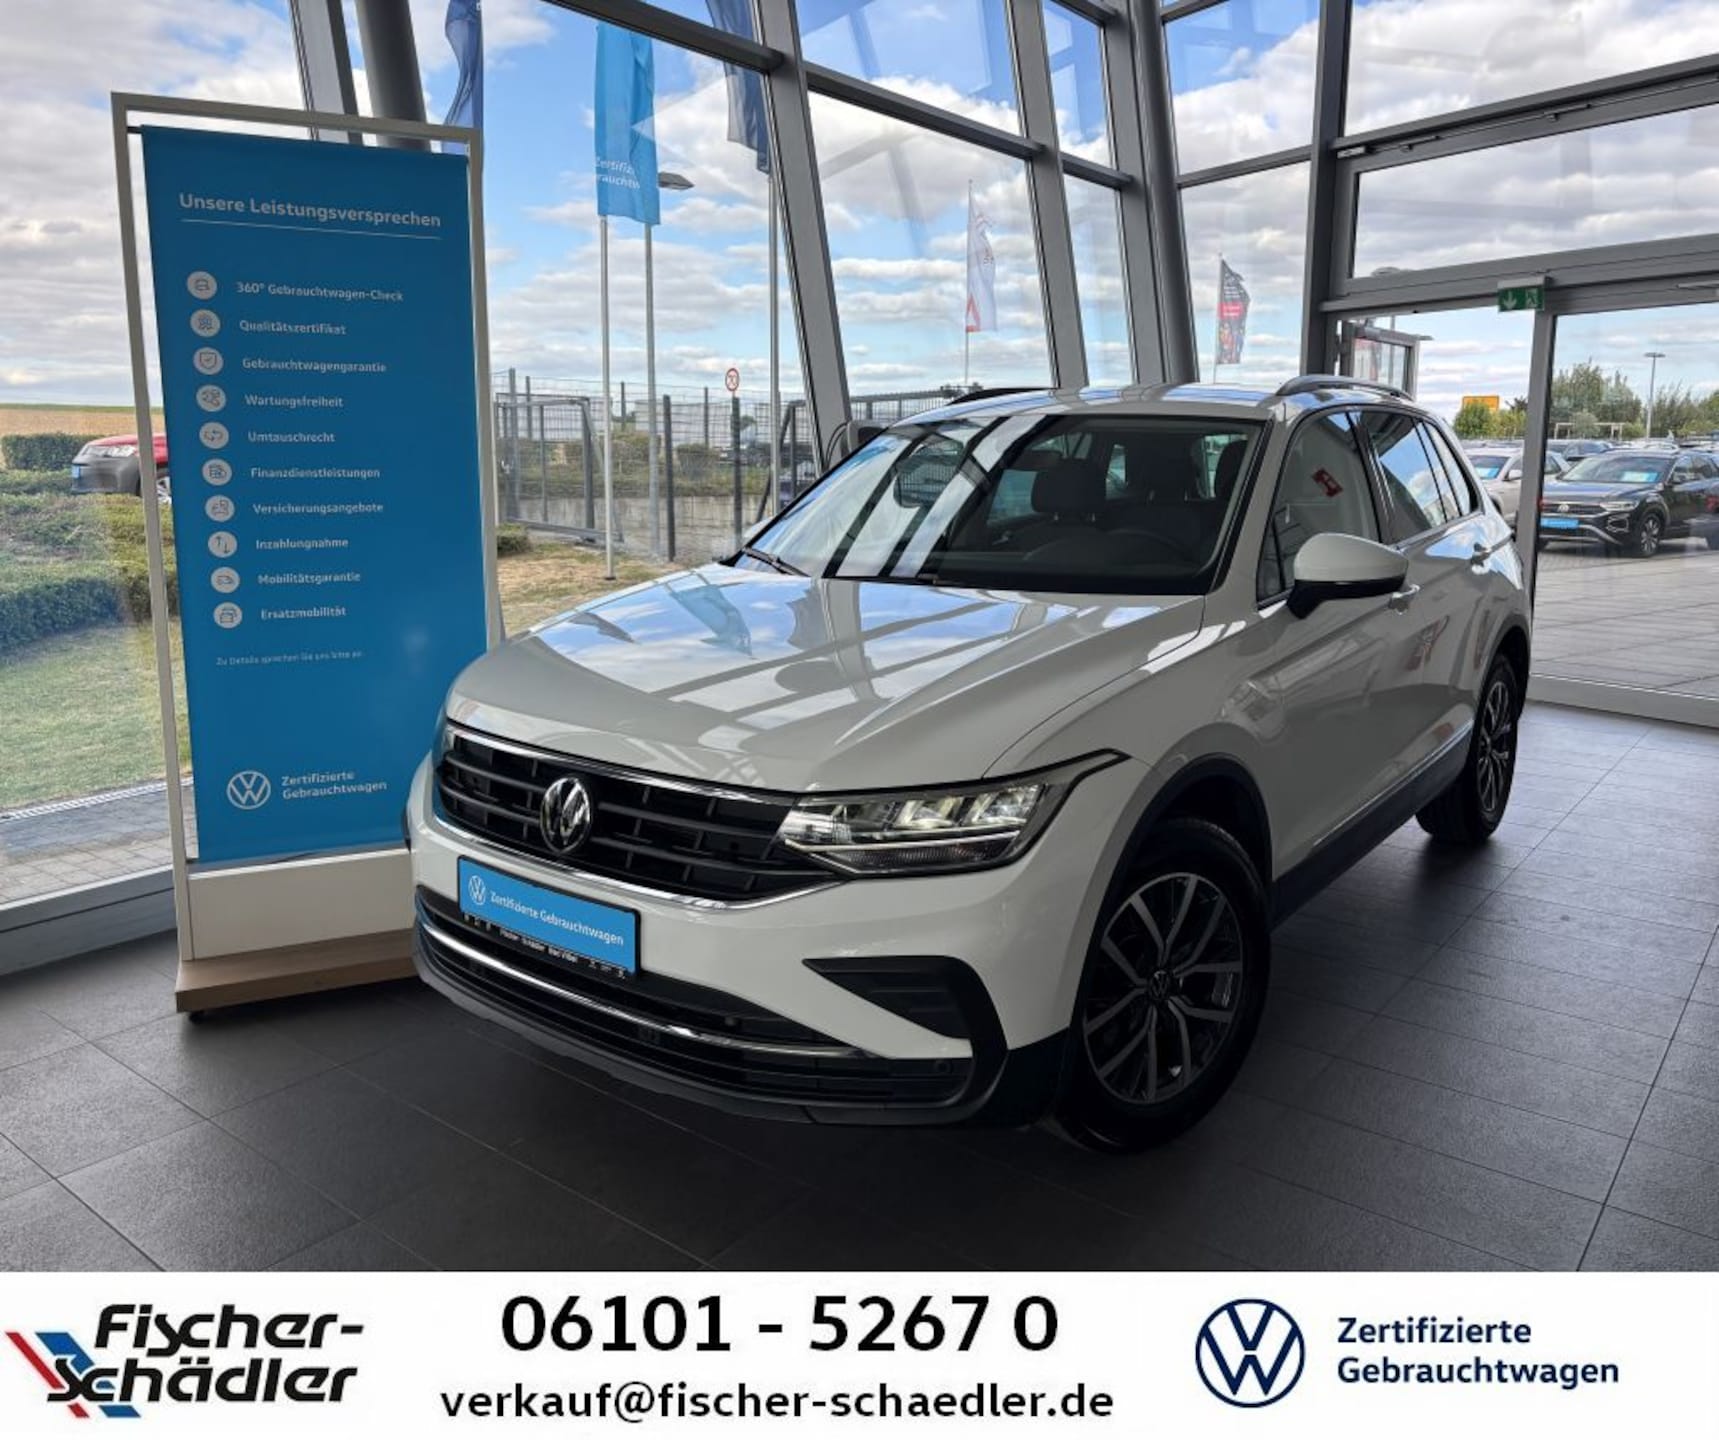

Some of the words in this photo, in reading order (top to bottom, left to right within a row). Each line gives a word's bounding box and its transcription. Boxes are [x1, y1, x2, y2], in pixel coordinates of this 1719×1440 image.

[179, 193, 246, 213] Unsere
[250, 198, 441, 228] Leistungsversprechen
[236, 281, 265, 294] 360°
[268, 284, 404, 302] Gebrauchtwagen-Check
[239, 320, 347, 336] Qualitätszertifikat
[242, 358, 387, 374] Gebrauchtwagengarantie
[244, 394, 344, 409] Wartungsfreiheit
[248, 431, 336, 443] Umtauschrecht
[251, 467, 380, 480] Finanzdienstleistungen
[253, 503, 384, 516] Versicherungsangebote
[256, 538, 349, 551] Inzahlungnahme
[258, 571, 361, 586] Mobilitätsgarantie
[261, 606, 347, 621] Ersatzmobilität
[281, 771, 355, 787] Zertifizierte
[282, 782, 388, 800] Gebrauchtwagen
[539, 910, 625, 947] Gebrauchtwagen
